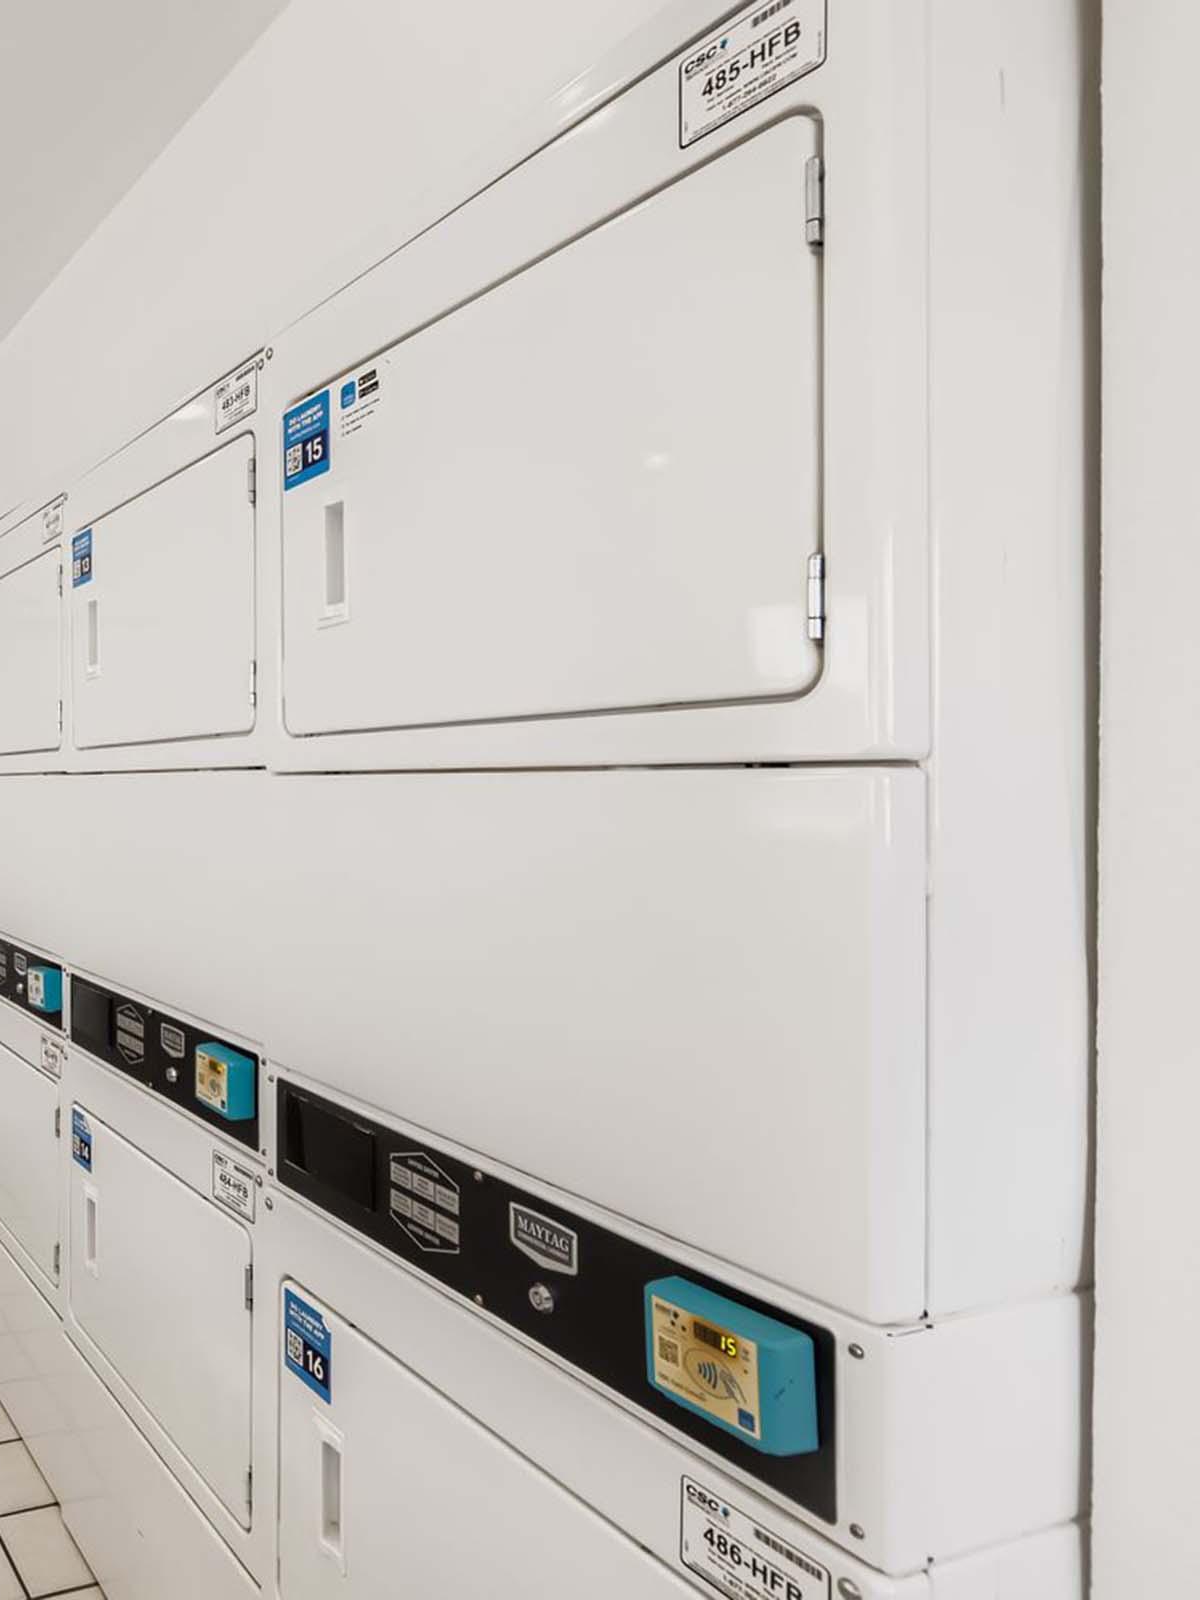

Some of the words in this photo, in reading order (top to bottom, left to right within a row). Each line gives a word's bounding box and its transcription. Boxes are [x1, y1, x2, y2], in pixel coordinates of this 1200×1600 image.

[684, 45, 718, 74] CSC
[701, 21, 801, 97] 485-HFB
[305, 437, 323, 464] 15
[516, 1214, 570, 1252] MAYTAG
[306, 1350, 324, 1381] 16
[686, 1484, 720, 1512] CSC
[703, 1527, 803, 1600] 486-HFB
